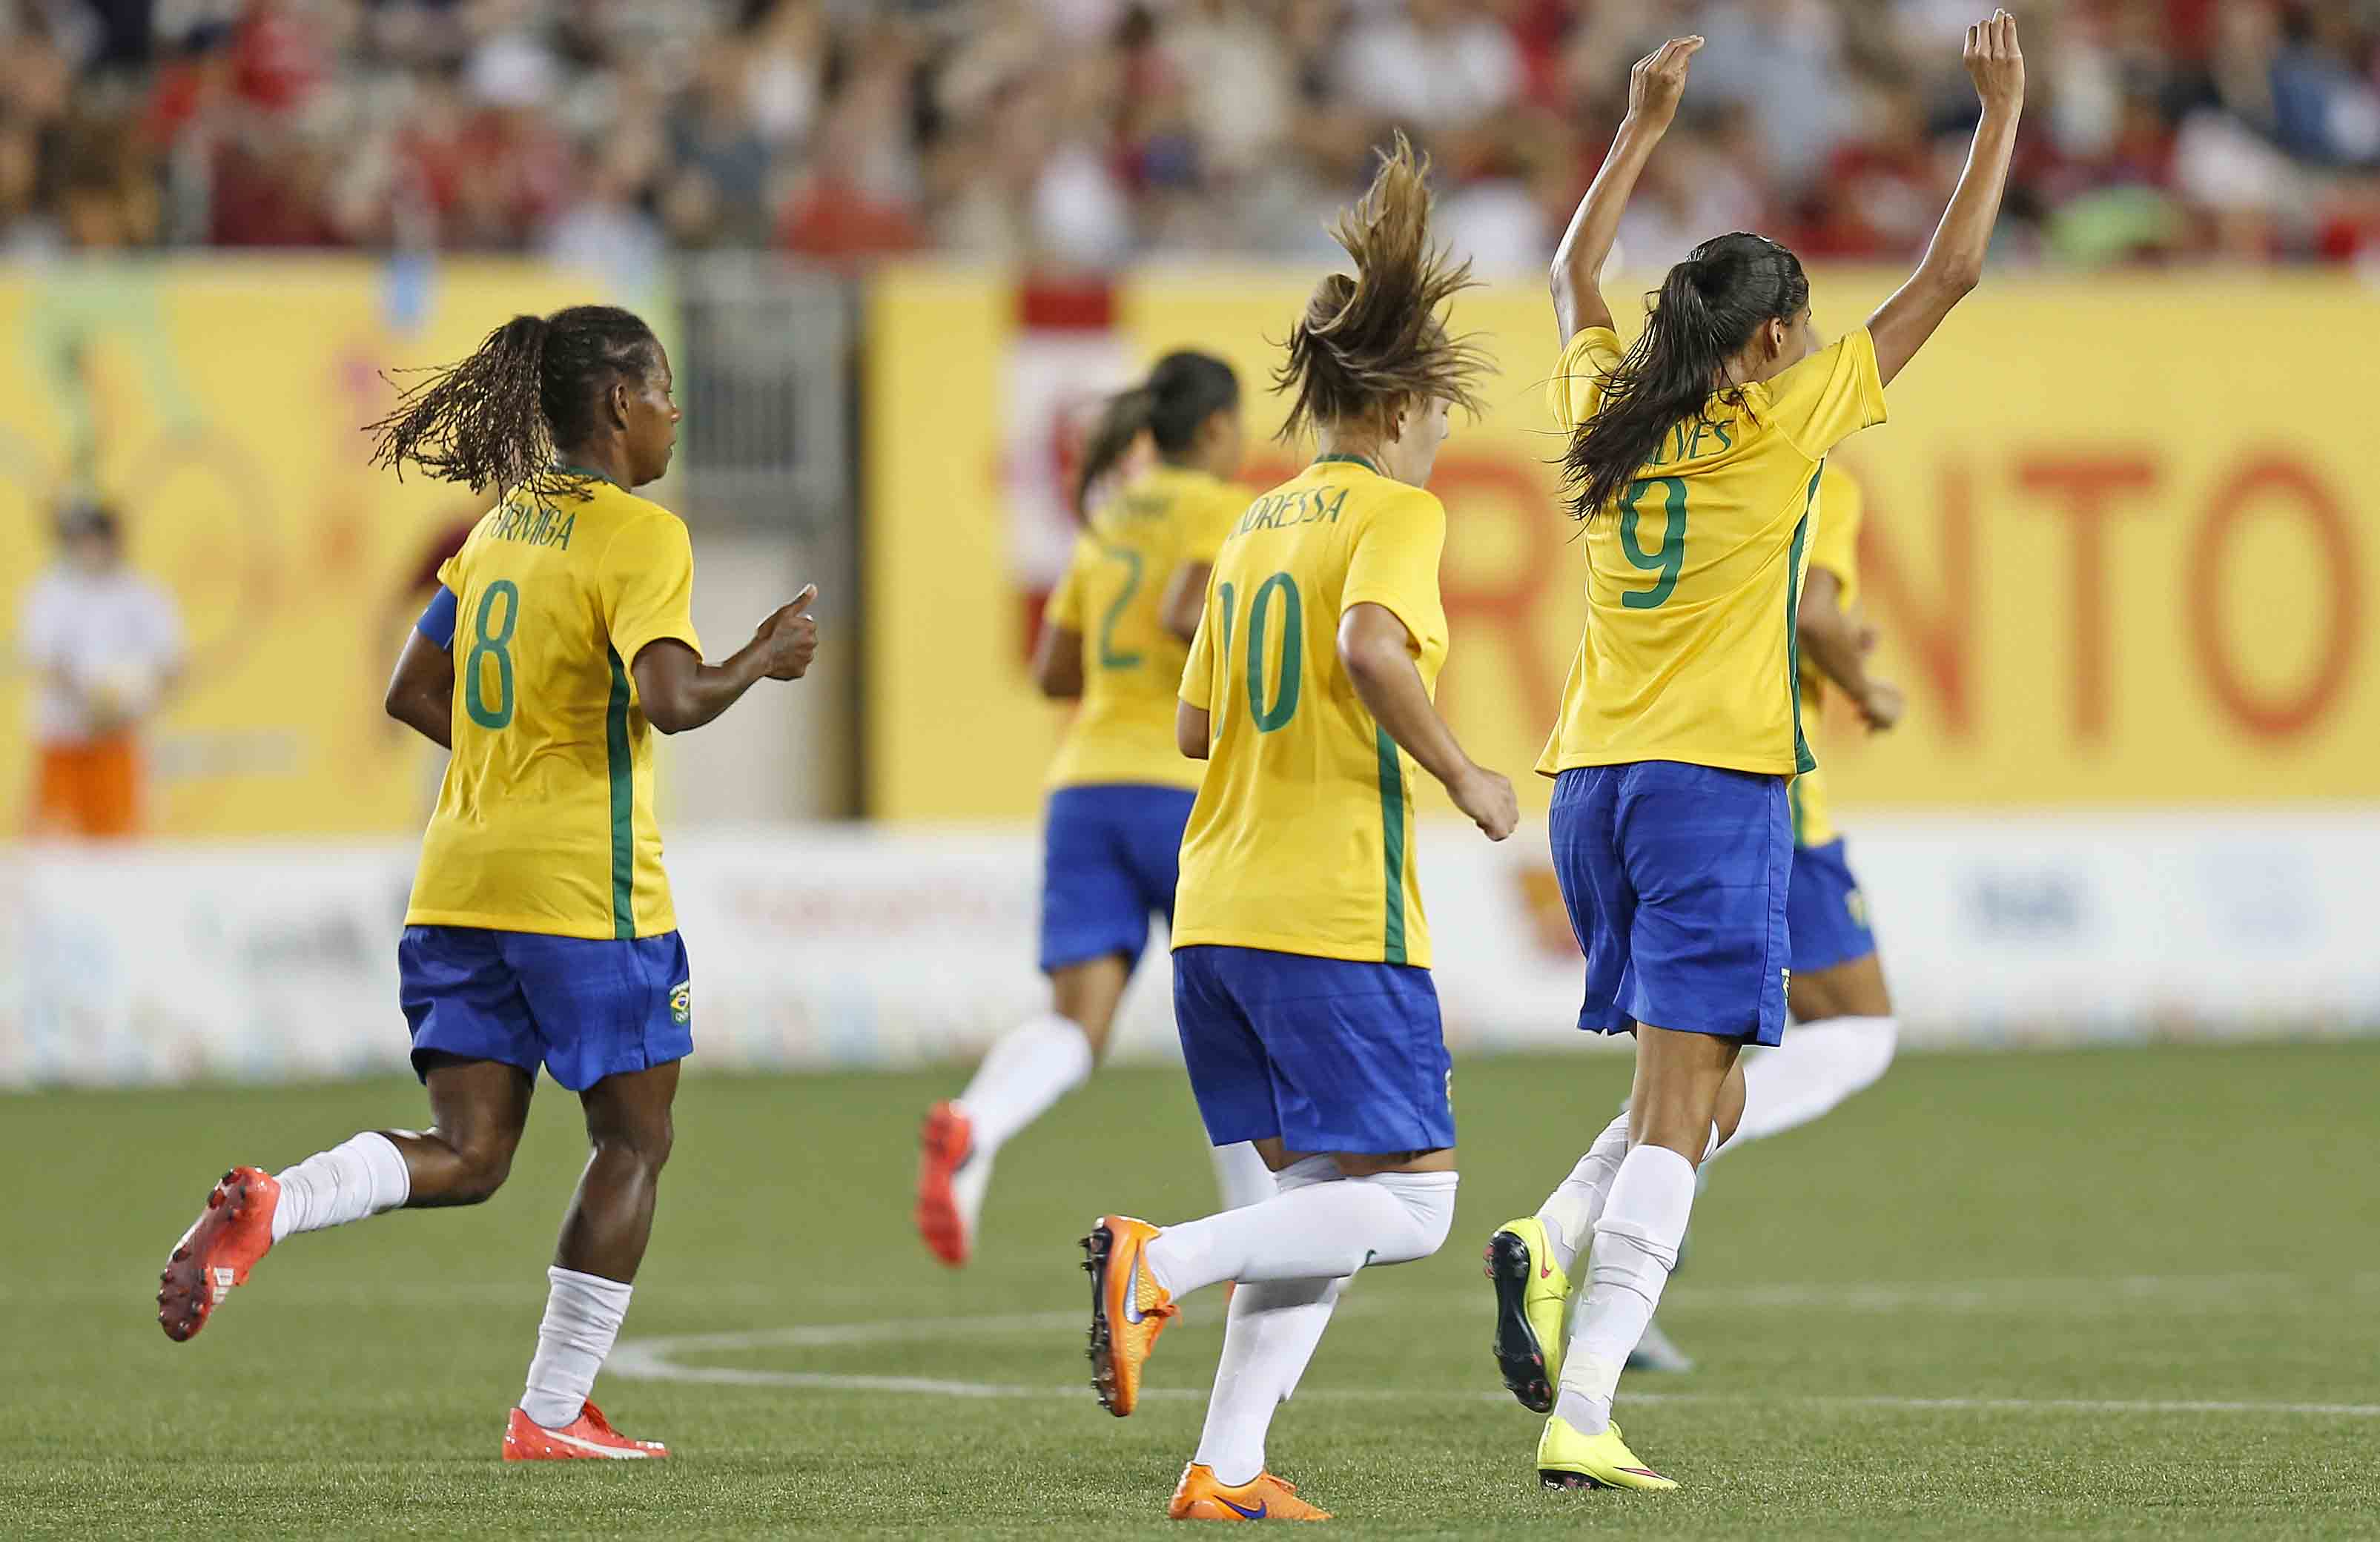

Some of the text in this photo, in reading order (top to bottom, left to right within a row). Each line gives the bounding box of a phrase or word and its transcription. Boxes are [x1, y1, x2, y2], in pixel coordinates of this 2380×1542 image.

[1100, 546, 1144, 669] 2
[1619, 476, 1688, 609] 9
[466, 578, 519, 729] 8
[1214, 572, 1303, 739] 10
